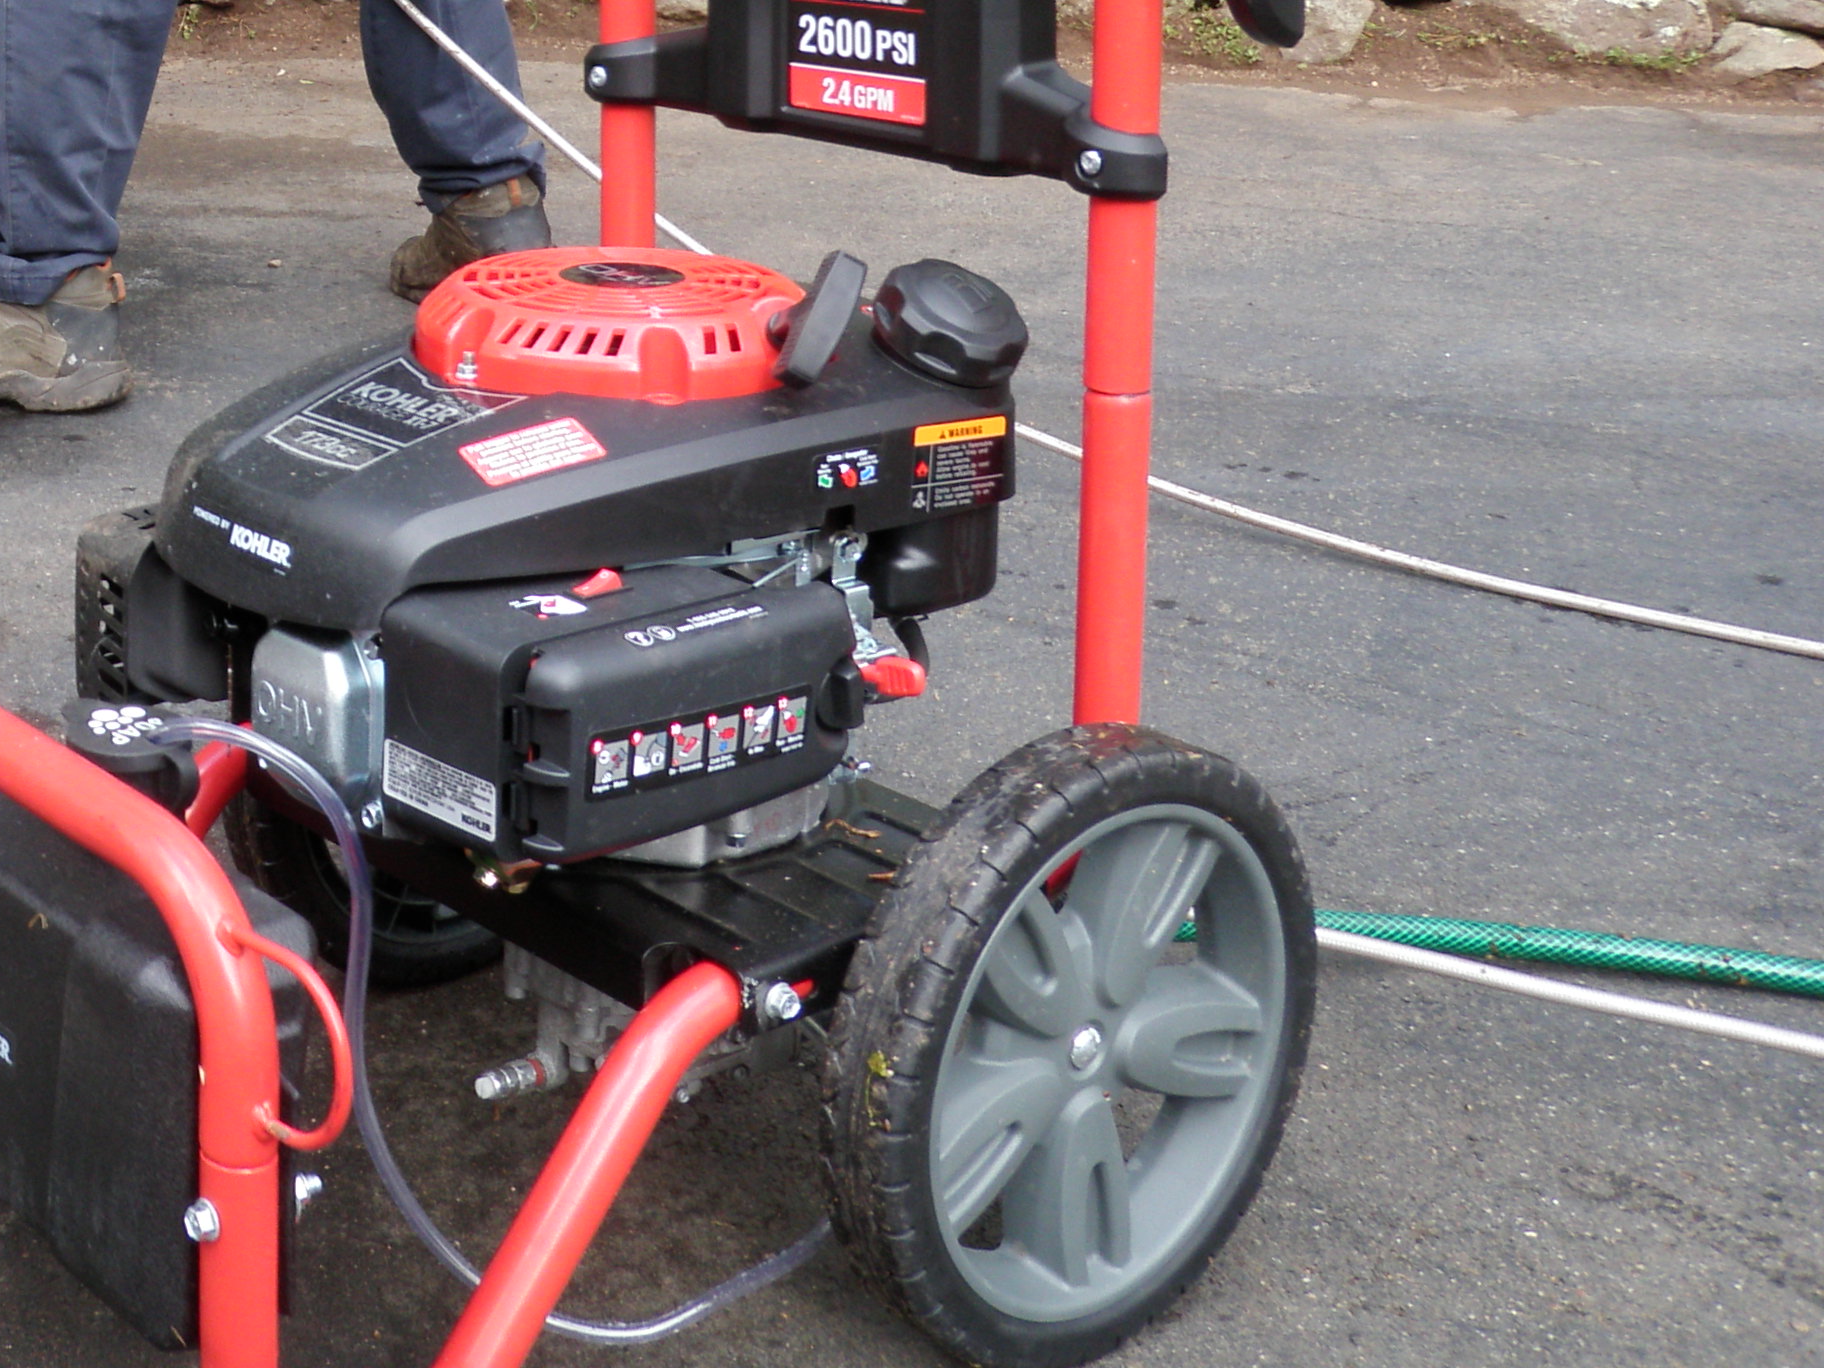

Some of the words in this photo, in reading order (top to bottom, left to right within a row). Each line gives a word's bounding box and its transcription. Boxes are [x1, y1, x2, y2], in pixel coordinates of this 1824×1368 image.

[798, 14, 872, 61] 2600
[876, 29, 916, 66] PSI
[822, 77, 851, 107] 2.4
[853, 84, 894, 113] GPM
[350, 381, 459, 426] KOHLER
[948, 425, 983, 438] WARNING
[230, 523, 291, 569] KOHLER
